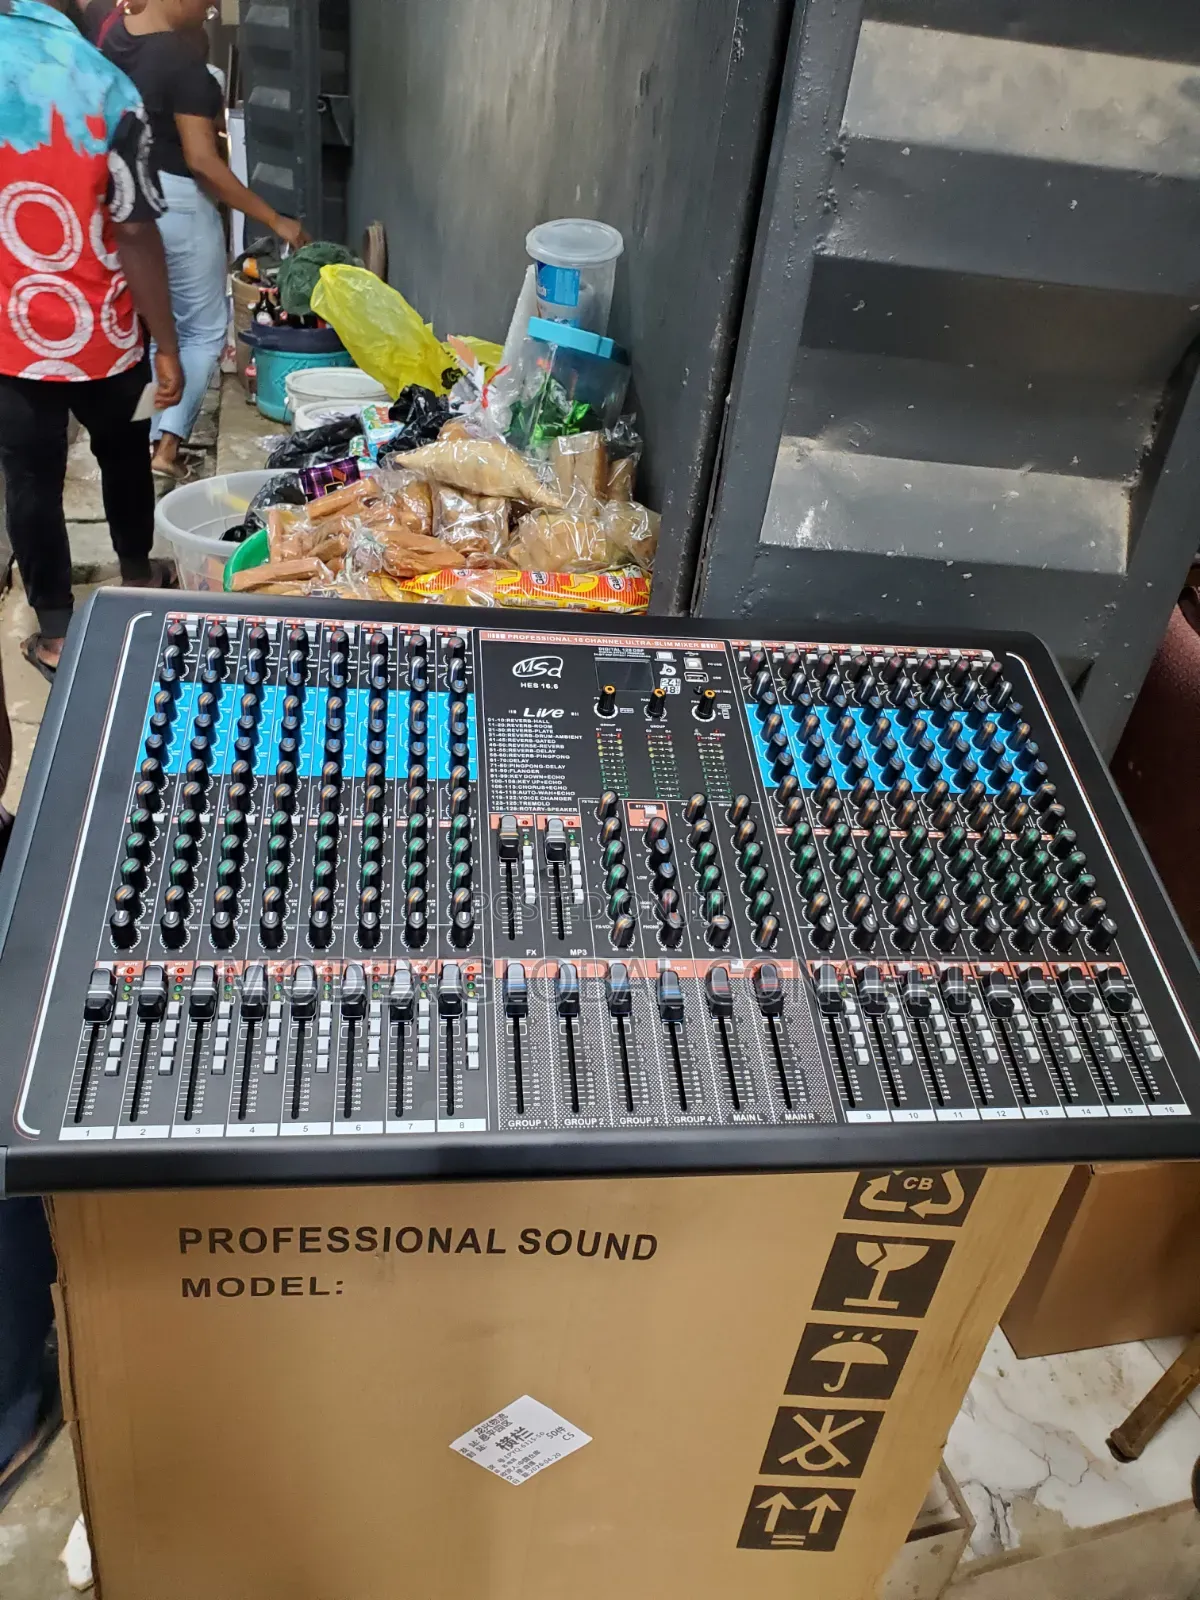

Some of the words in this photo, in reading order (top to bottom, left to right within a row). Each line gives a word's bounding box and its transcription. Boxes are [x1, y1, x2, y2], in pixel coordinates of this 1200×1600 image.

[508, 634, 572, 642] PROFESSIONAL
[524, 708, 564, 718] Live
[904, 1176, 934, 1190] CB
[179, 1226, 506, 1254] PROFESSIONAL
[518, 1228, 658, 1260] SOUND
[182, 1276, 343, 1298] MODEL:
[495, 1426, 534, 1452] 横栏
[546, 1426, 567, 1439] 50件
[562, 1432, 575, 1441] C5
